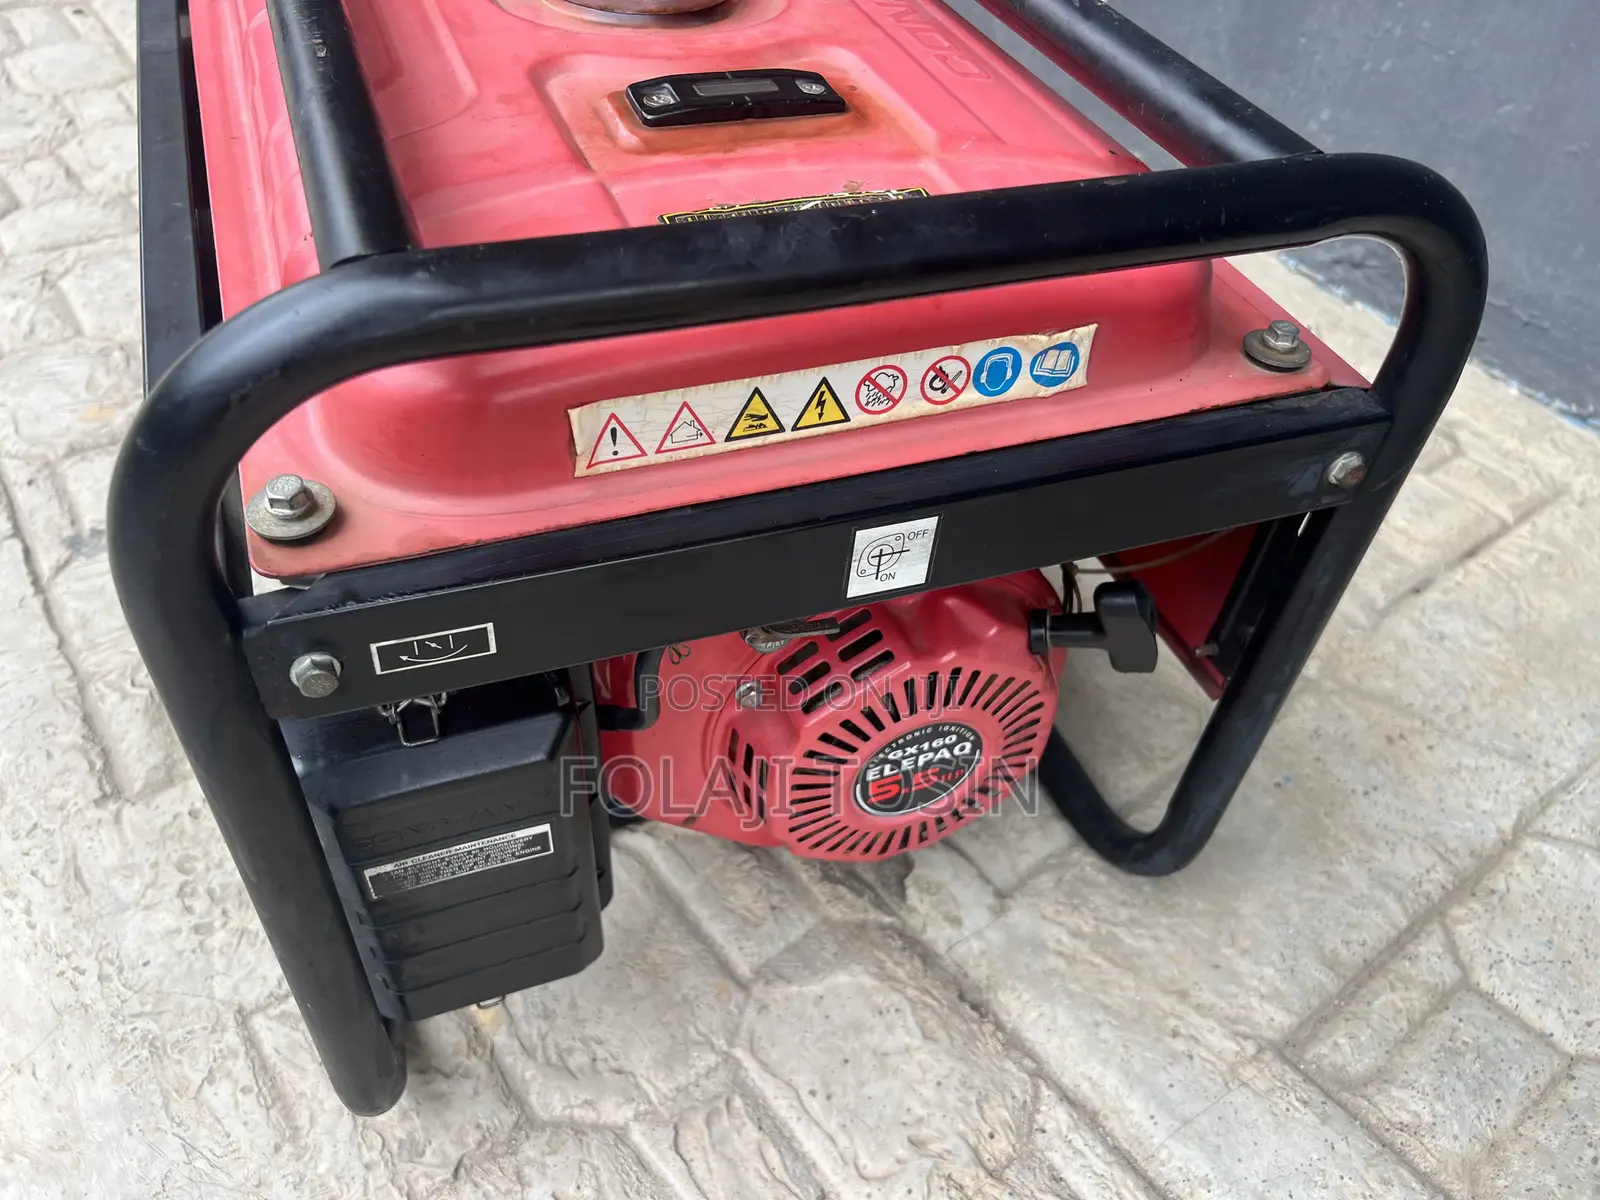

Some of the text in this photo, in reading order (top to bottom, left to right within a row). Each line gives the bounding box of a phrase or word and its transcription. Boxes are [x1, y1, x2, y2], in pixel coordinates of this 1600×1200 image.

[907, 528, 929, 541] OFF
[880, 571, 896, 582] ON
[868, 725, 976, 768] ELECTRONIC IGNITION
[887, 734, 958, 760] GX160
[393, 833, 517, 869] AIR CLEANER MAINTENANCE
[488, 853, 512, 862] CLEAN
[515, 846, 542, 856] ENGINE
[407, 859, 441, 871] ELEMENT
[445, 852, 468, 861] EVERY
[422, 861, 447, 871] UNDER
[451, 855, 474, 864] DUSTY
